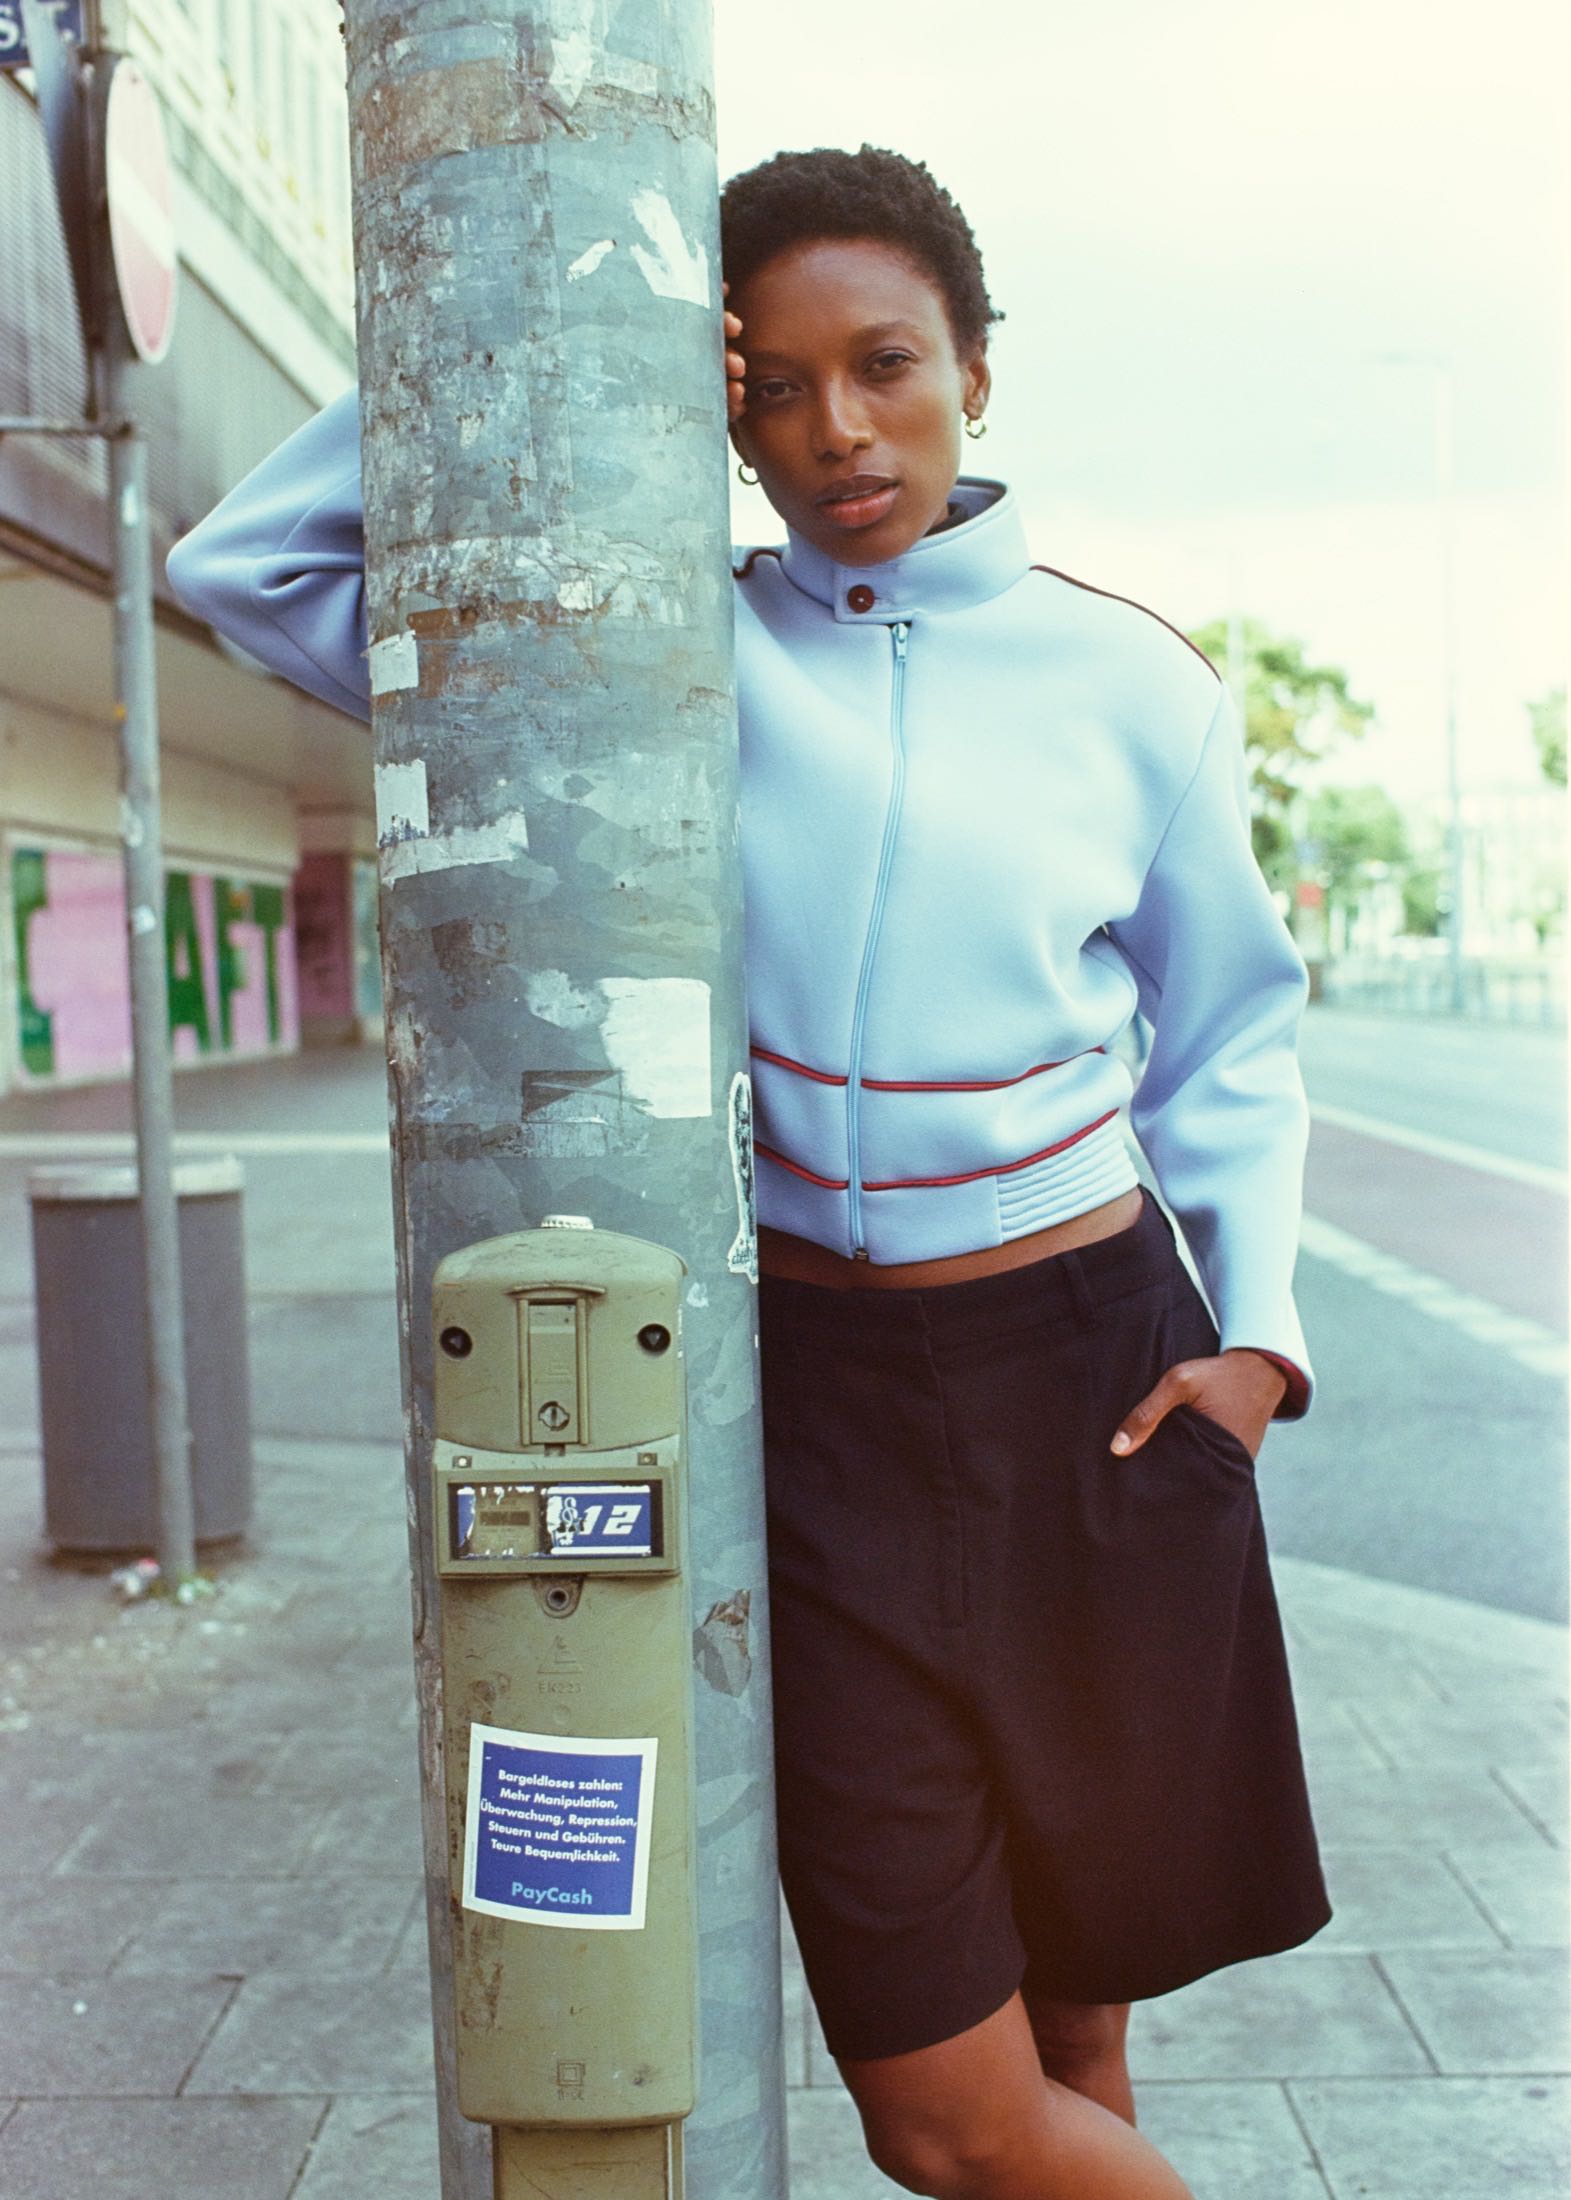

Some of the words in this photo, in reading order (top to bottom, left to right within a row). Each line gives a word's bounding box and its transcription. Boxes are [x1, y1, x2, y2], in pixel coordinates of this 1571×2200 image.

[578, 1504, 643, 1536] 12
[498, 1770, 575, 1789] Bargeldloses
[578, 1779, 623, 1791] zahlen:
[500, 1788, 530, 1802] Mehr
[533, 1793, 618, 1809] Manipulation,
[480, 1798, 565, 1826] Überwachung,
[568, 1814, 637, 1828] Repression,
[488, 1821, 531, 1838] Steuern
[535, 1831, 559, 1841] und
[562, 1831, 625, 1844] Gebühren.
[491, 1839, 521, 1854] Teure
[525, 1846, 620, 1863] Bequemlichkeit.
[512, 1882, 592, 1905] PayCash
